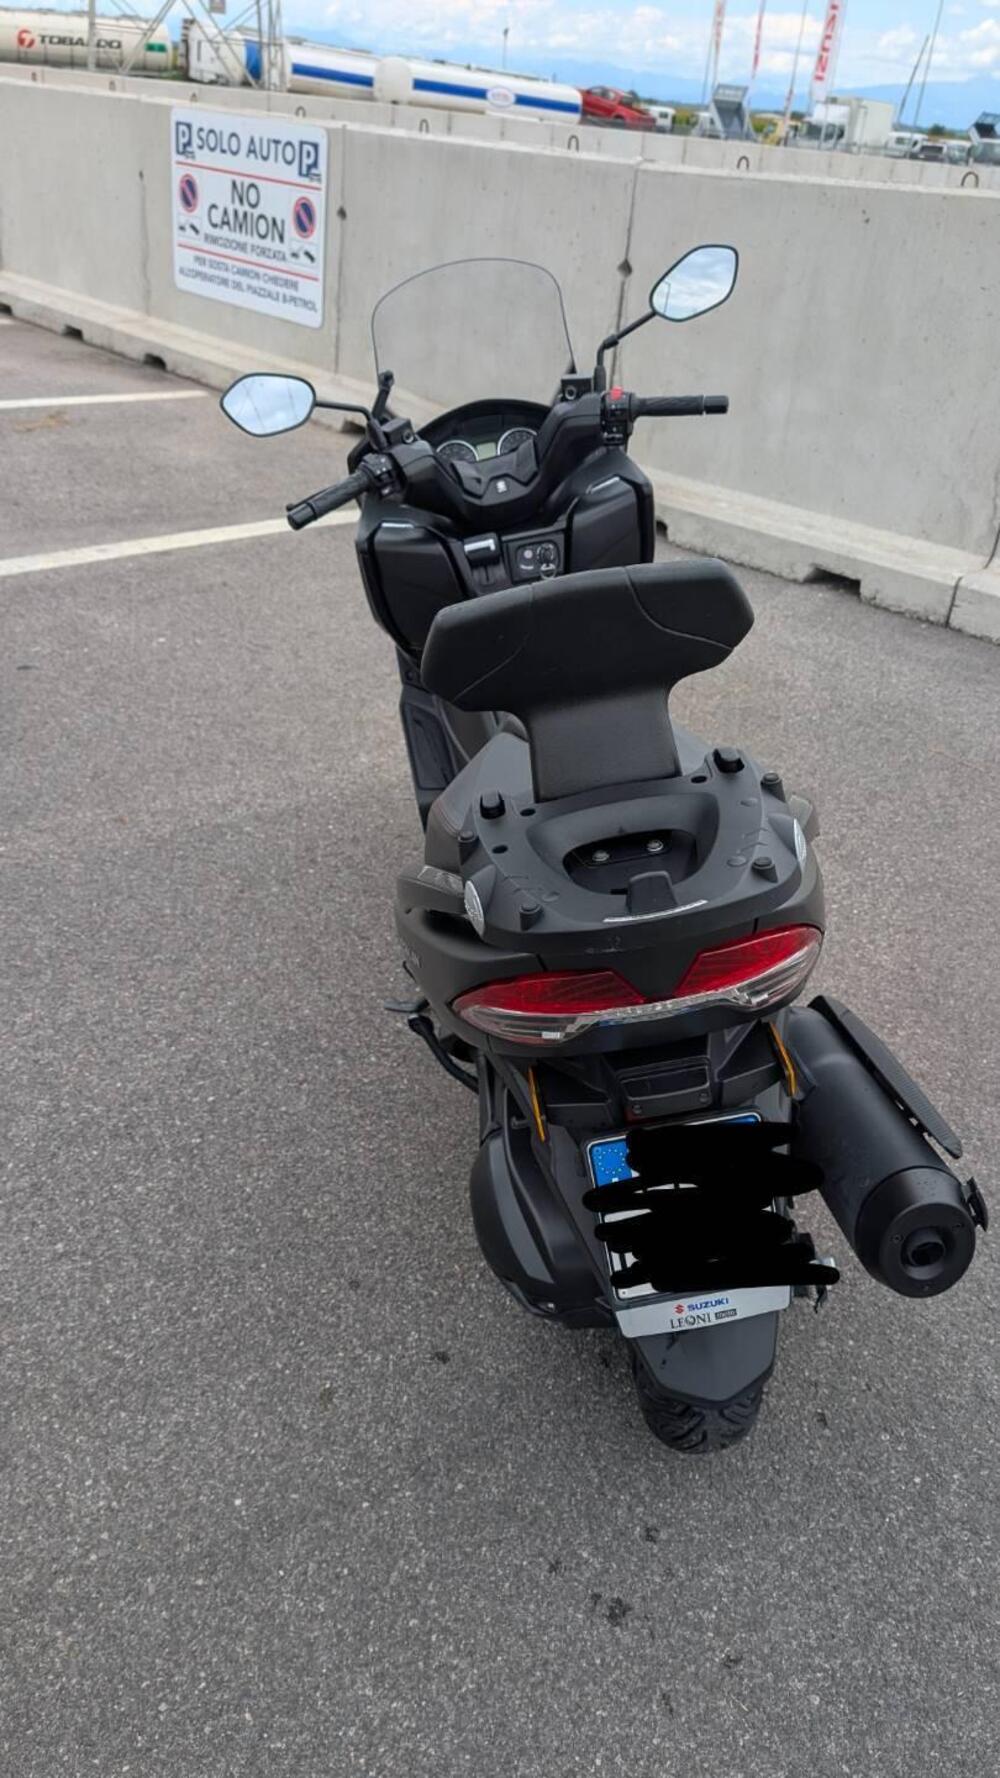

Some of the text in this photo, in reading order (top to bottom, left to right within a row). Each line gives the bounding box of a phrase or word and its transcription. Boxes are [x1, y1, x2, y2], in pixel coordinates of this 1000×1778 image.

[40, 34, 122, 50] TOBADO
[197, 127, 241, 156] SOLO
[246, 135, 296, 166] AUTO
[231, 179, 260, 209] NO
[207, 203, 285, 244] CAMION
[203, 233, 287, 262] RIMOZIONE FORZATA
[193, 255, 299, 292] PER SOSTA CAMION CHIEDERE
[231, 279, 245, 292] DEL
[246, 284, 280, 302] PIAZZALE
[687, 1297, 729, 1311] SUZUKI
[670, 1312, 711, 1329] LEONI
